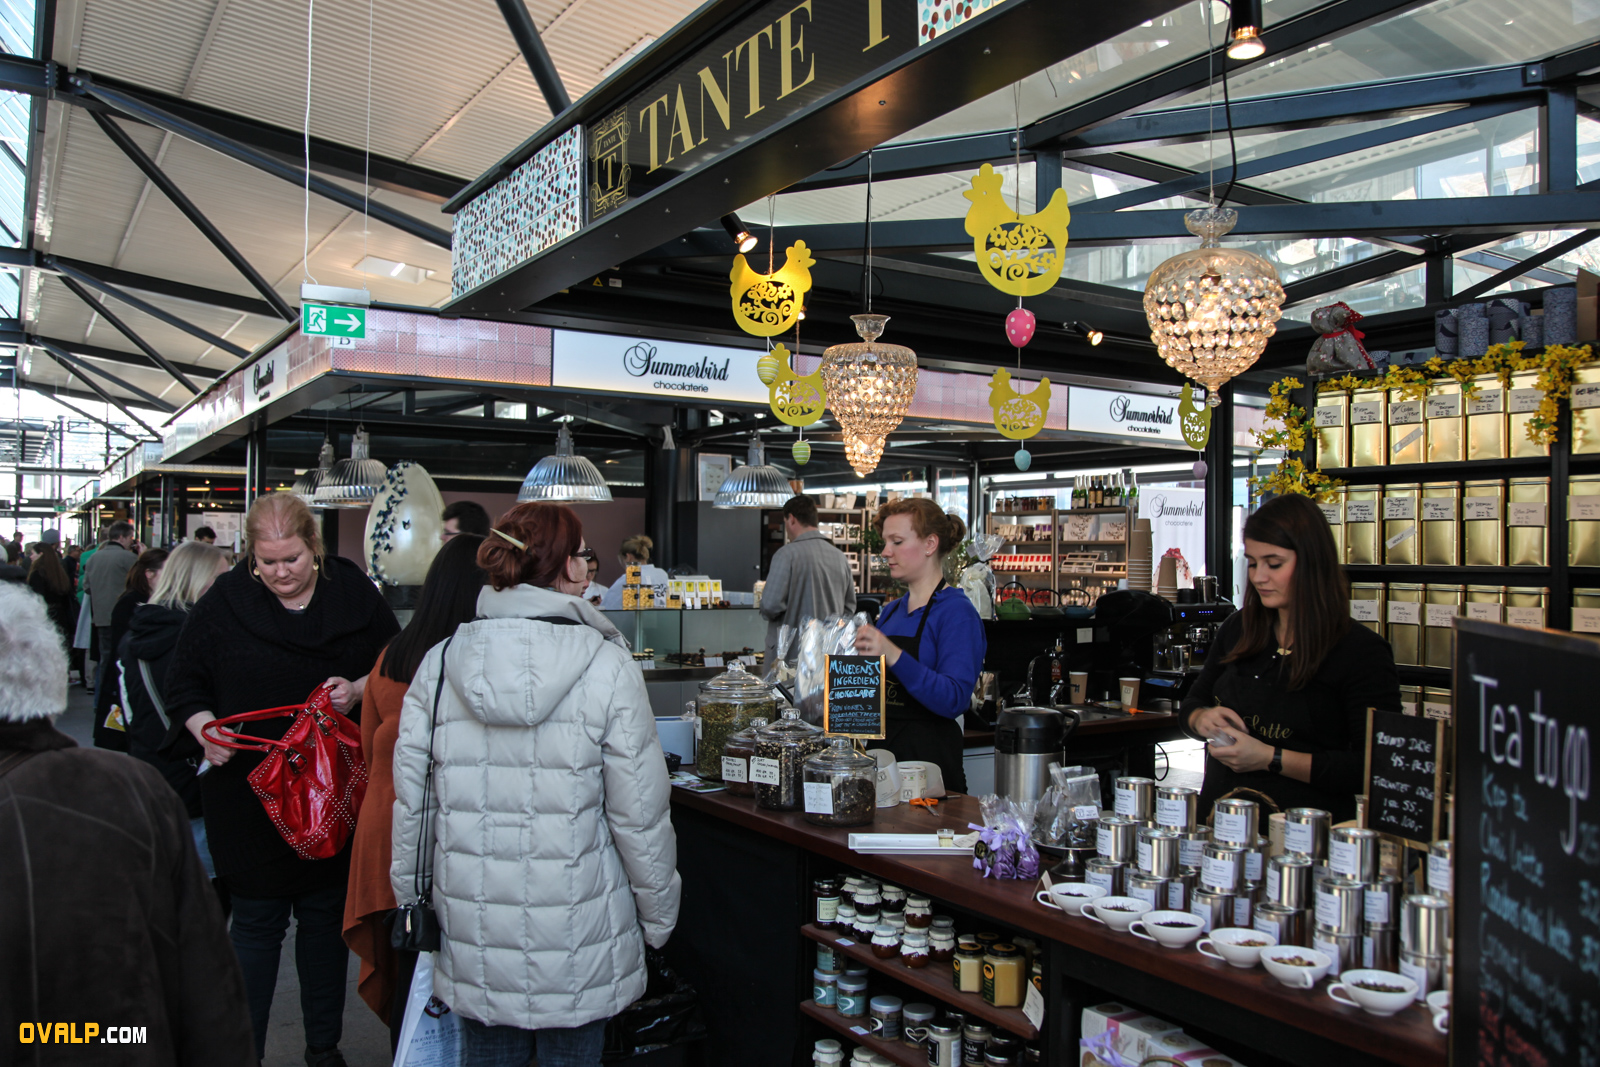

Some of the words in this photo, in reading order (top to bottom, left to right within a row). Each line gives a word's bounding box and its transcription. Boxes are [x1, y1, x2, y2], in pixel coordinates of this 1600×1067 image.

[639, 0, 815, 174] TANTE
[602, 151, 617, 191] T
[624, 341, 730, 381] Summerbird
[653, 380, 709, 393] chocolaterie
[1109, 395, 1174, 425] Summerbird
[1127, 424, 1161, 435] chocolaterie
[1149, 493, 1204, 518] Summerbird
[828, 689, 877, 701] CHOKOLADE
[1471, 673, 1522, 769] Tea
[1528, 689, 1559, 788] to
[1561, 724, 1591, 856] go
